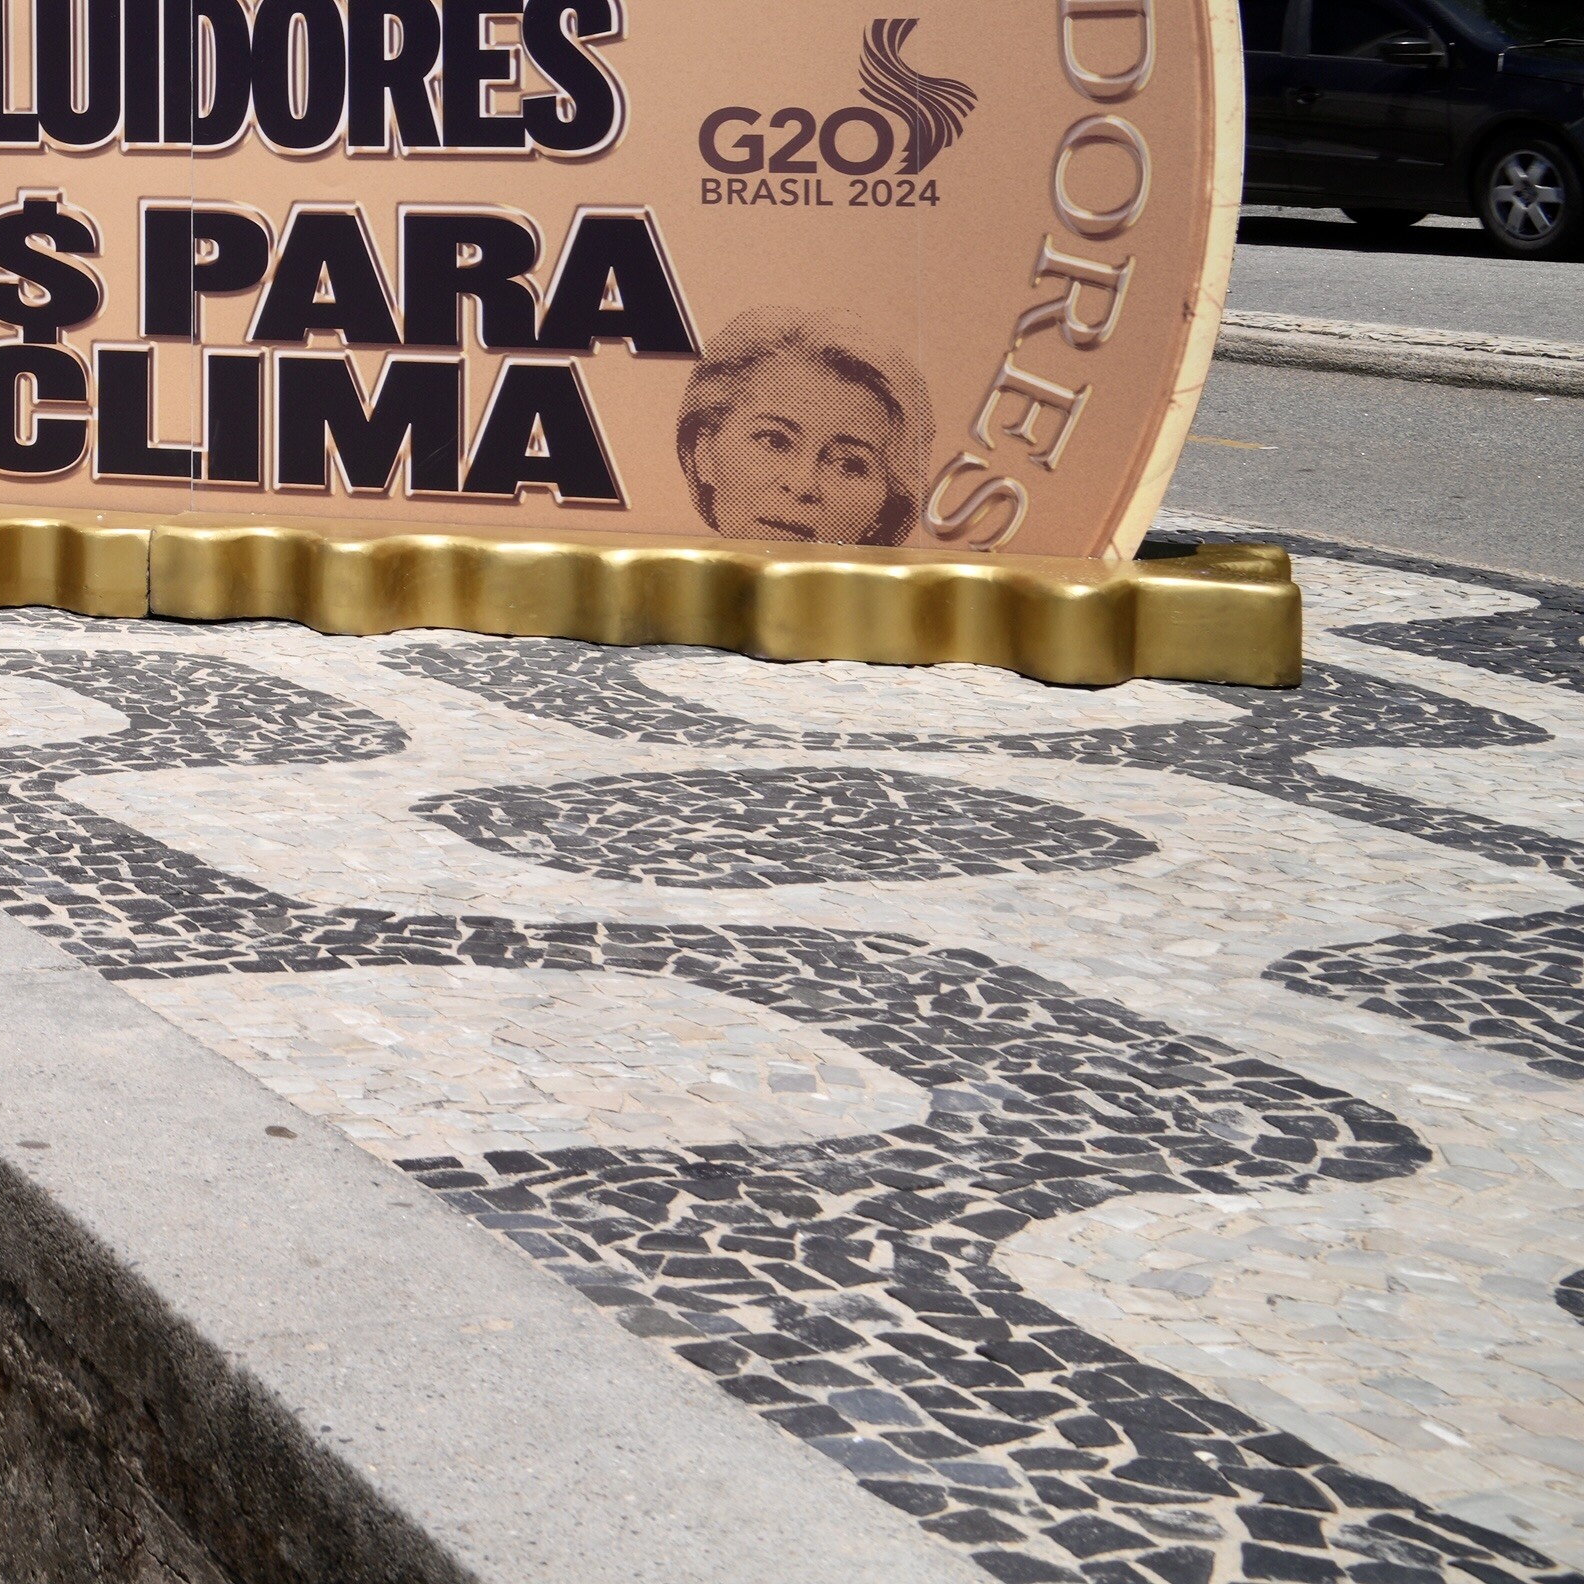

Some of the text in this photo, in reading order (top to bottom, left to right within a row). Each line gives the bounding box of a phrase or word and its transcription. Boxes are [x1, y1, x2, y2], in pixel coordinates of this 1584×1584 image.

[698, 106, 894, 175] G20
[700, 178, 941, 207] BRASIL 2024
[138, 198, 702, 356] PARA
